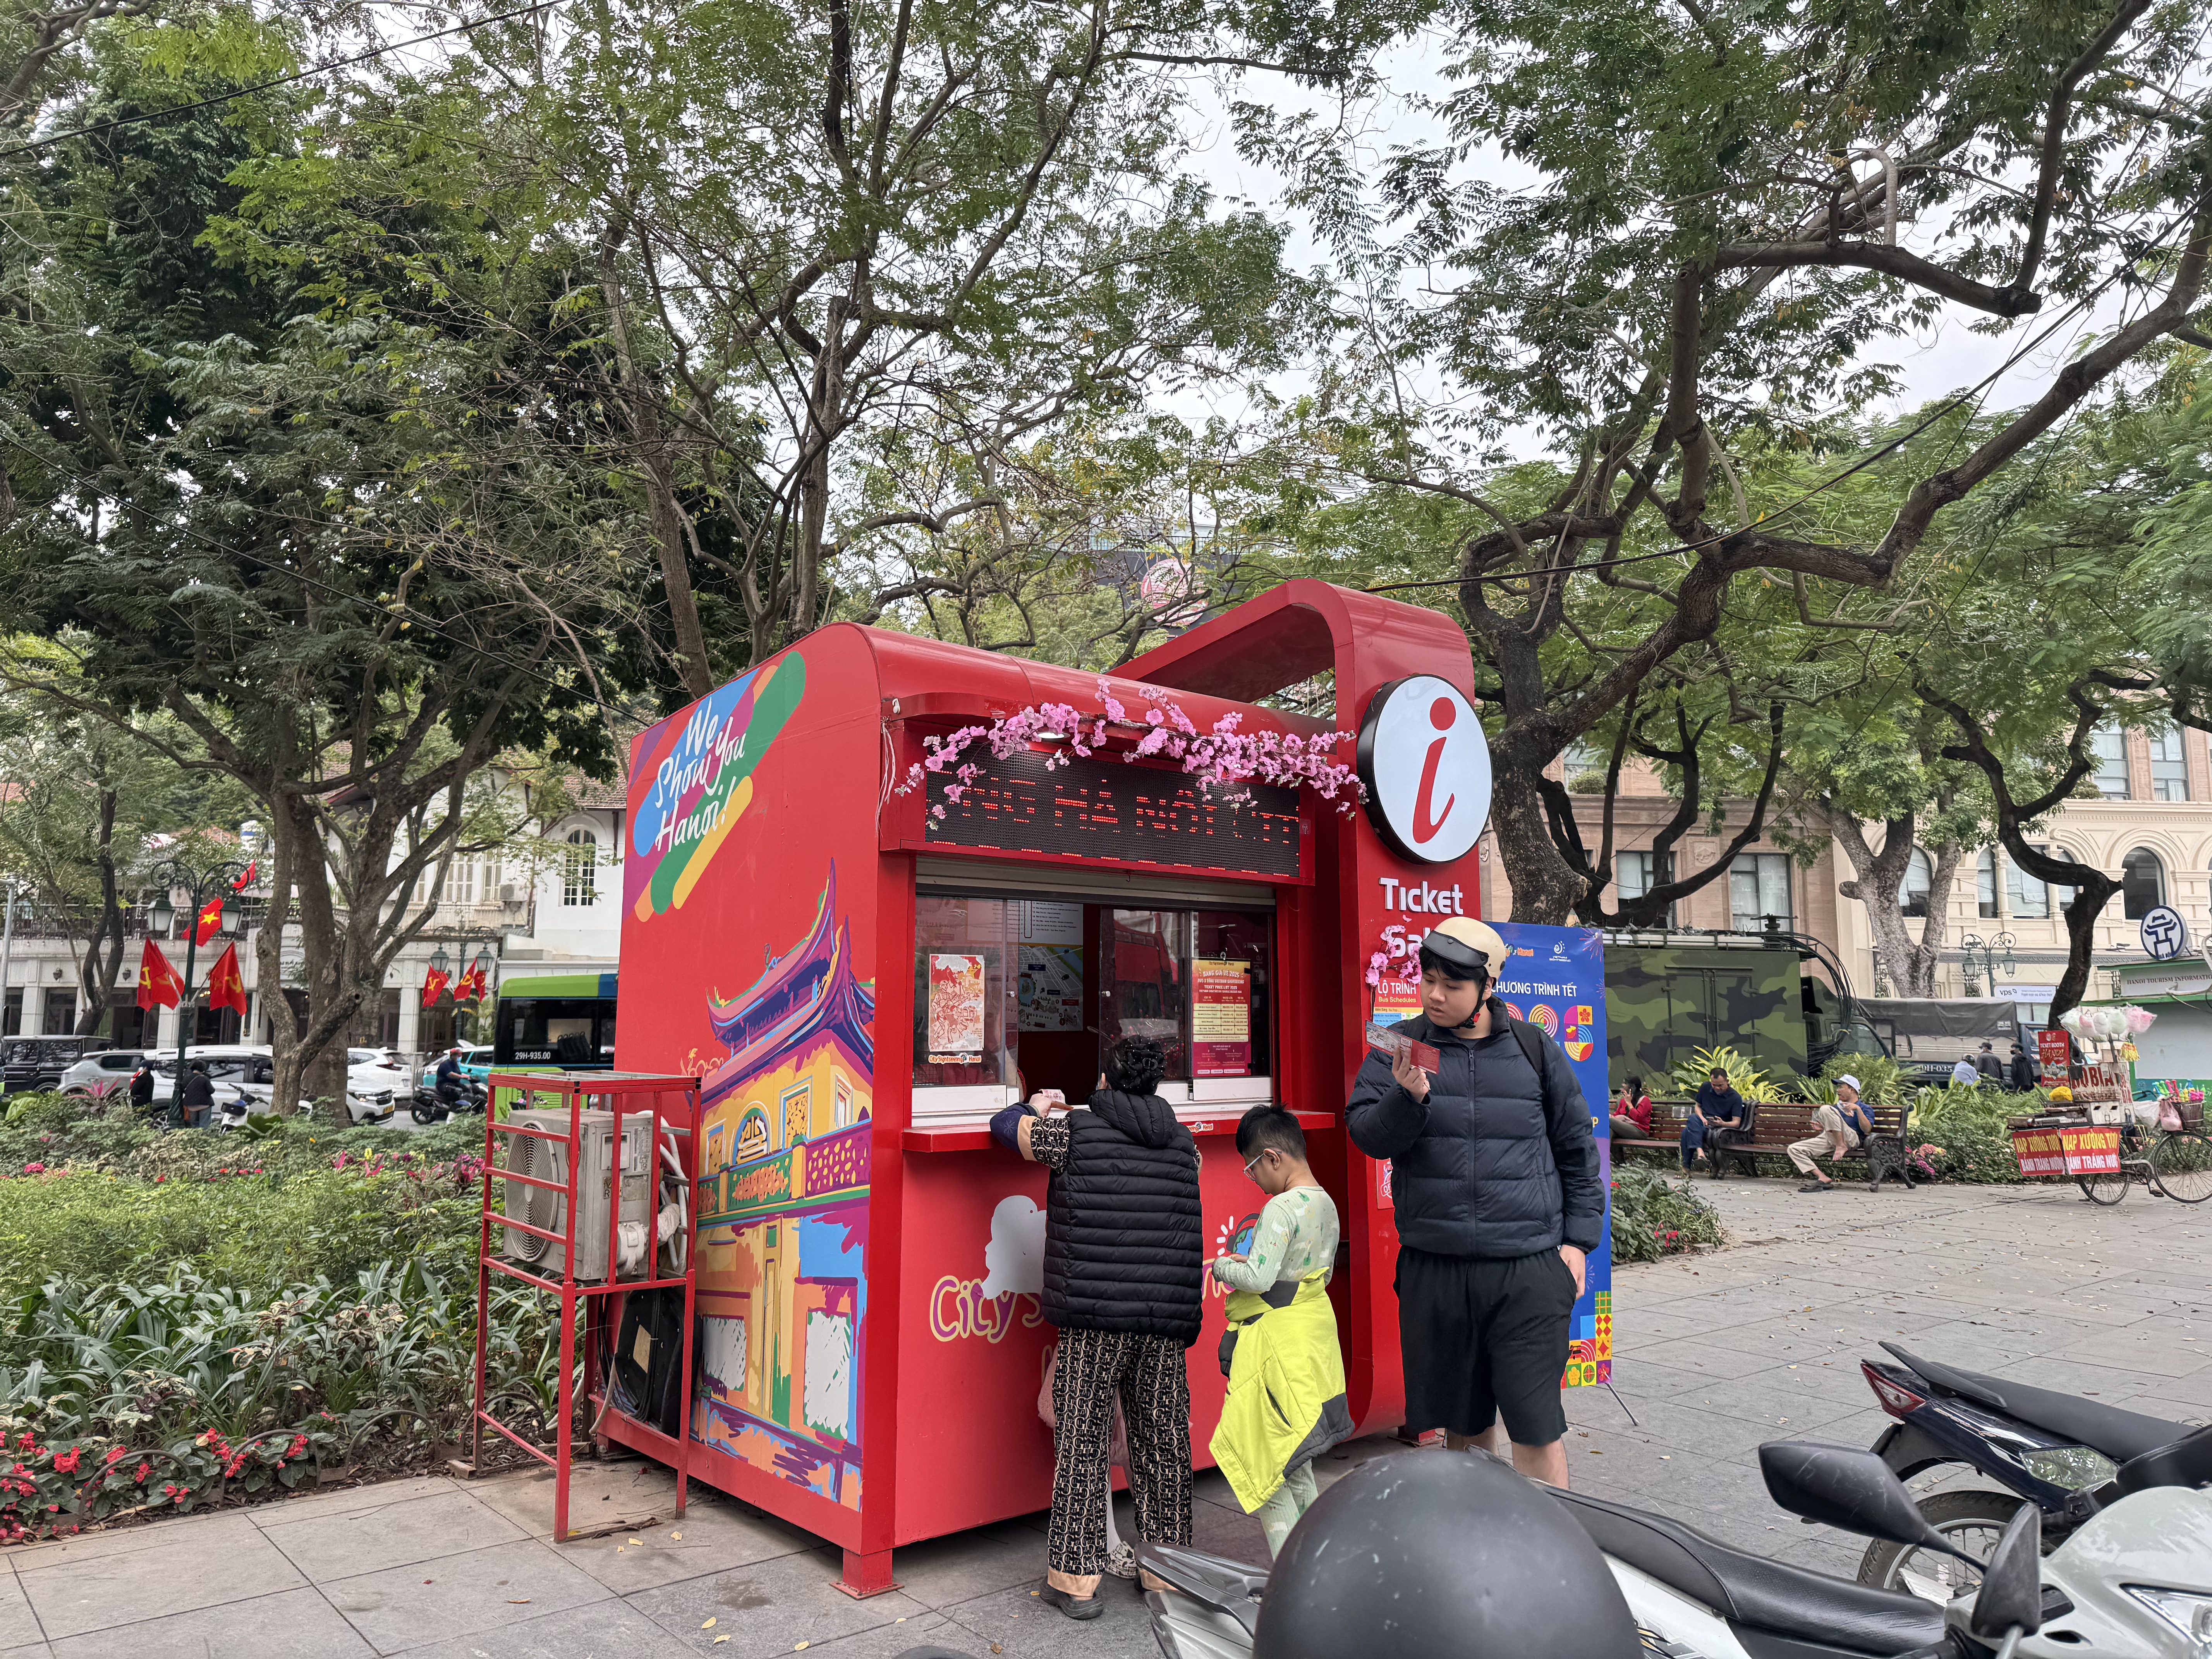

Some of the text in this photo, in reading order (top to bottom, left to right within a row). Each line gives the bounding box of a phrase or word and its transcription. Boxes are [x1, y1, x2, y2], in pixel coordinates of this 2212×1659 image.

[685, 697, 719, 756] We
[655, 716, 746, 809] Show You
[655, 776, 737, 852] Hanoi!
[1379, 877, 1463, 915] Ticket
[1390, 979, 1417, 994] TRÌNH
[1533, 982, 1560, 996] TRÌNH
[1562, 982, 1577, 997] TẾT
